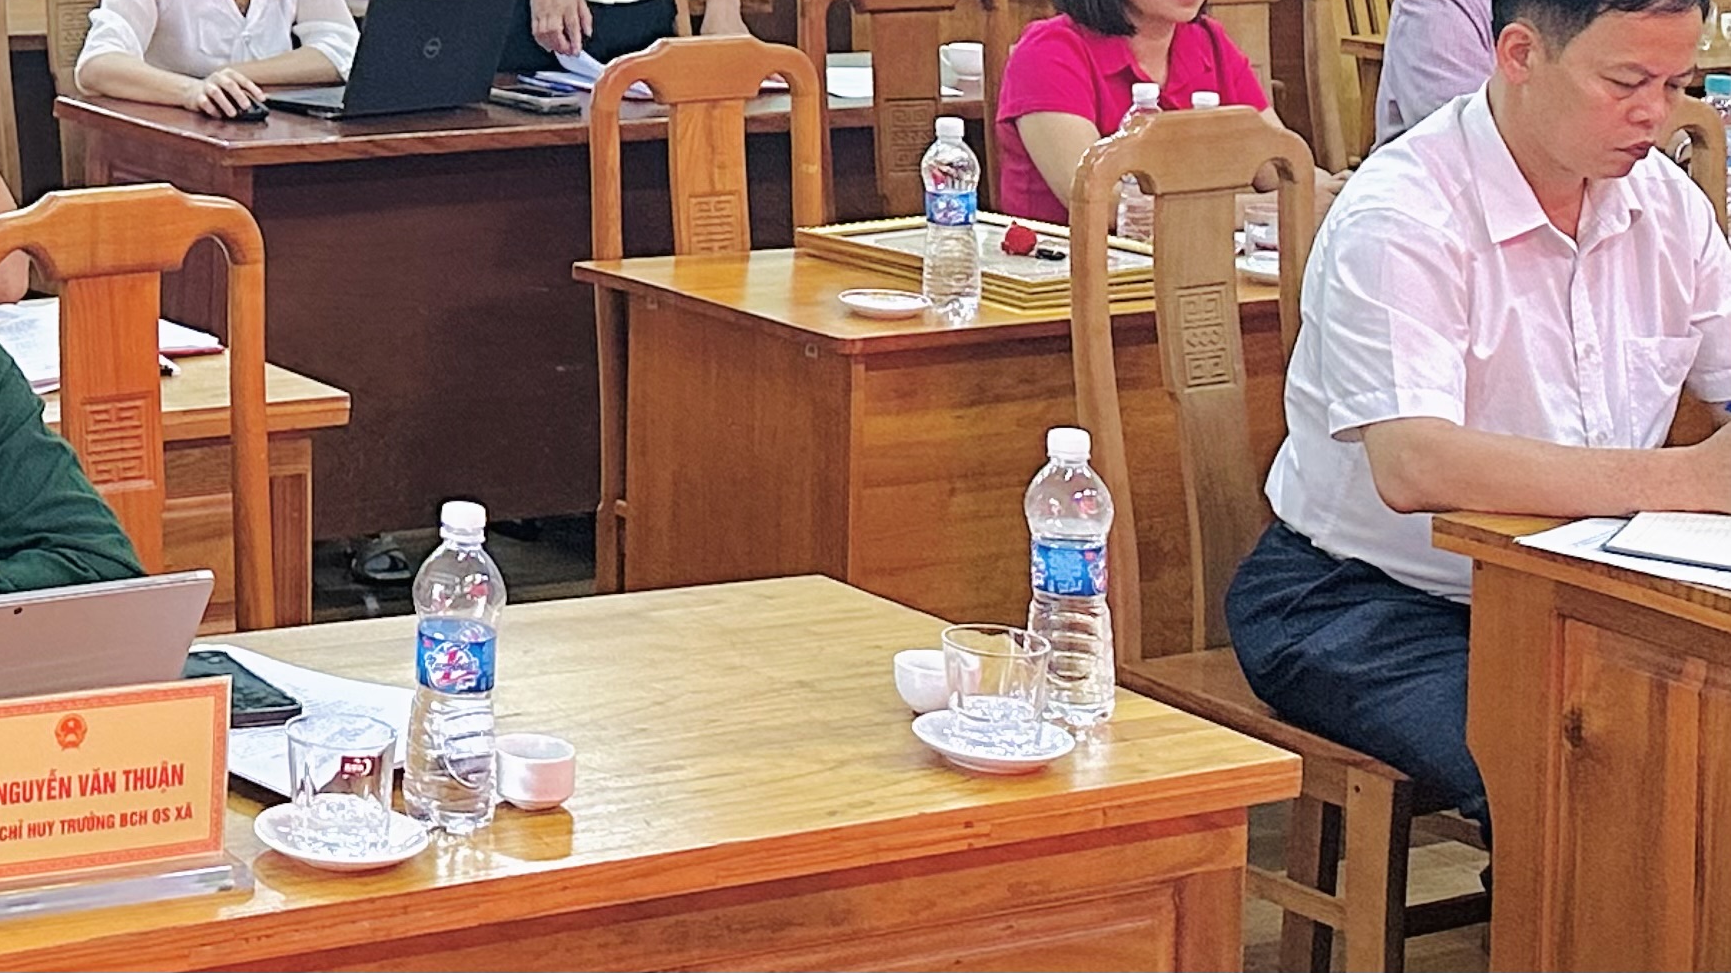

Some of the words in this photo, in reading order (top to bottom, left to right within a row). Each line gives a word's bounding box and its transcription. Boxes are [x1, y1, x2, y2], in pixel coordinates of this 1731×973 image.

[77, 768, 117, 797] VĂN
[122, 760, 185, 793] THUẬN
[27, 820, 55, 839] HUY
[119, 809, 148, 828] BCH
[151, 807, 171, 825] QS
